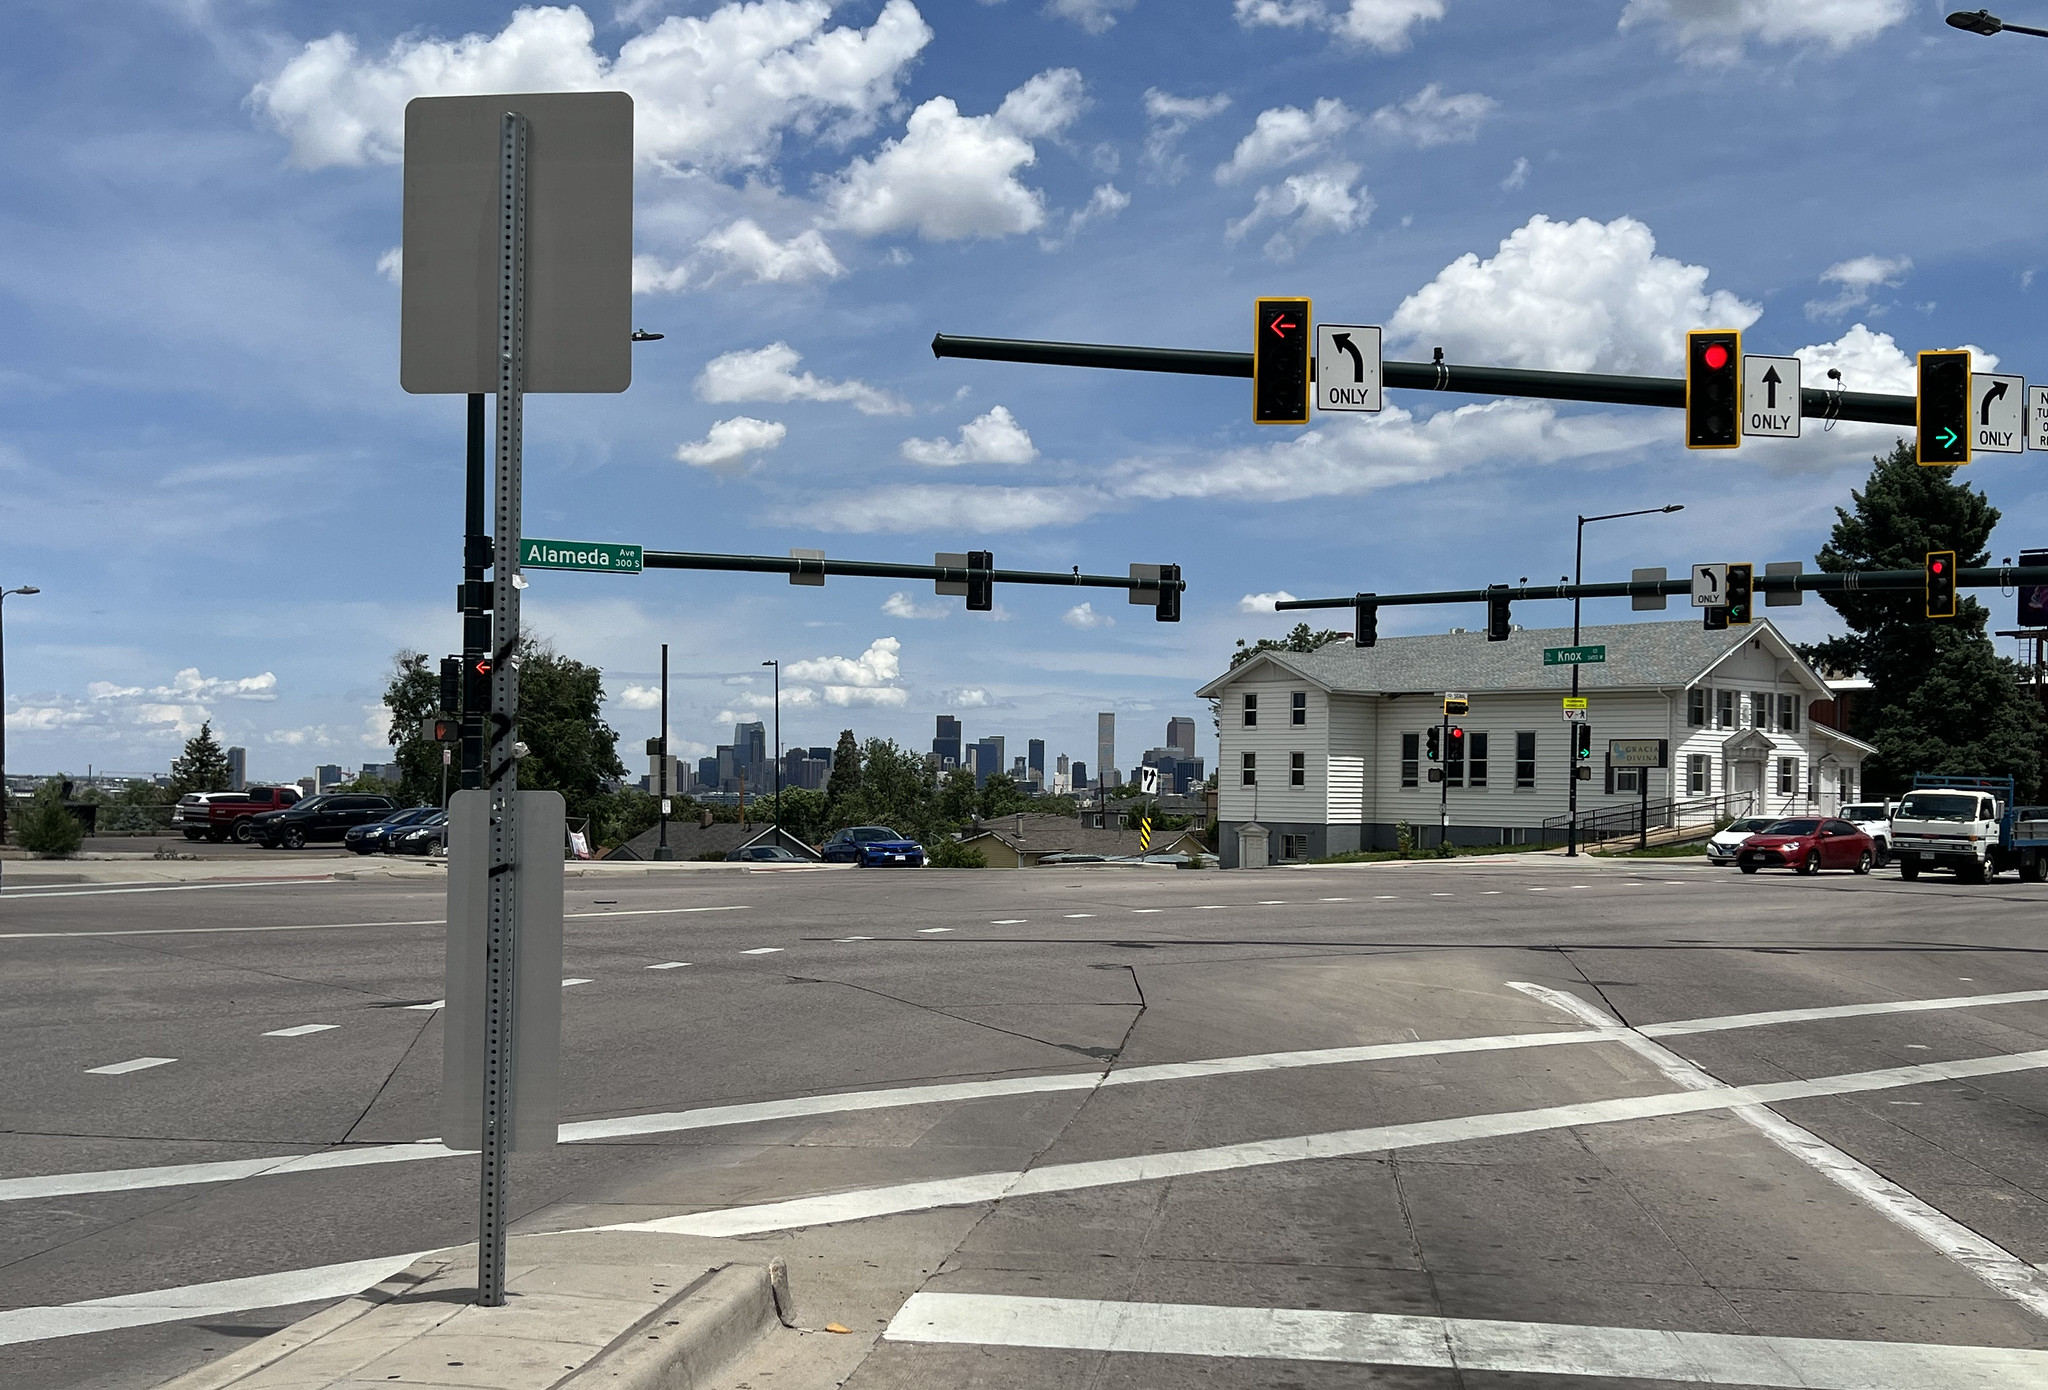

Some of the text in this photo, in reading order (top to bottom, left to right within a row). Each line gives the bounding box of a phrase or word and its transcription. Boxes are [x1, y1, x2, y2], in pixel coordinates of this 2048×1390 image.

[1330, 387, 1369, 405] ONLY
[2041, 391, 2048, 405] N
[2037, 407, 2048, 418] TU
[1751, 413, 1792, 430] ONLY
[2043, 421, 2048, 433] O
[1980, 430, 2013, 446] ONLY
[527, 544, 610, 566] Alameda
[619, 548, 635, 558] Ave
[614, 558, 641, 568] 300 S
[1697, 594, 1720, 604] ONLY
[1557, 651, 1582, 662] Knox
